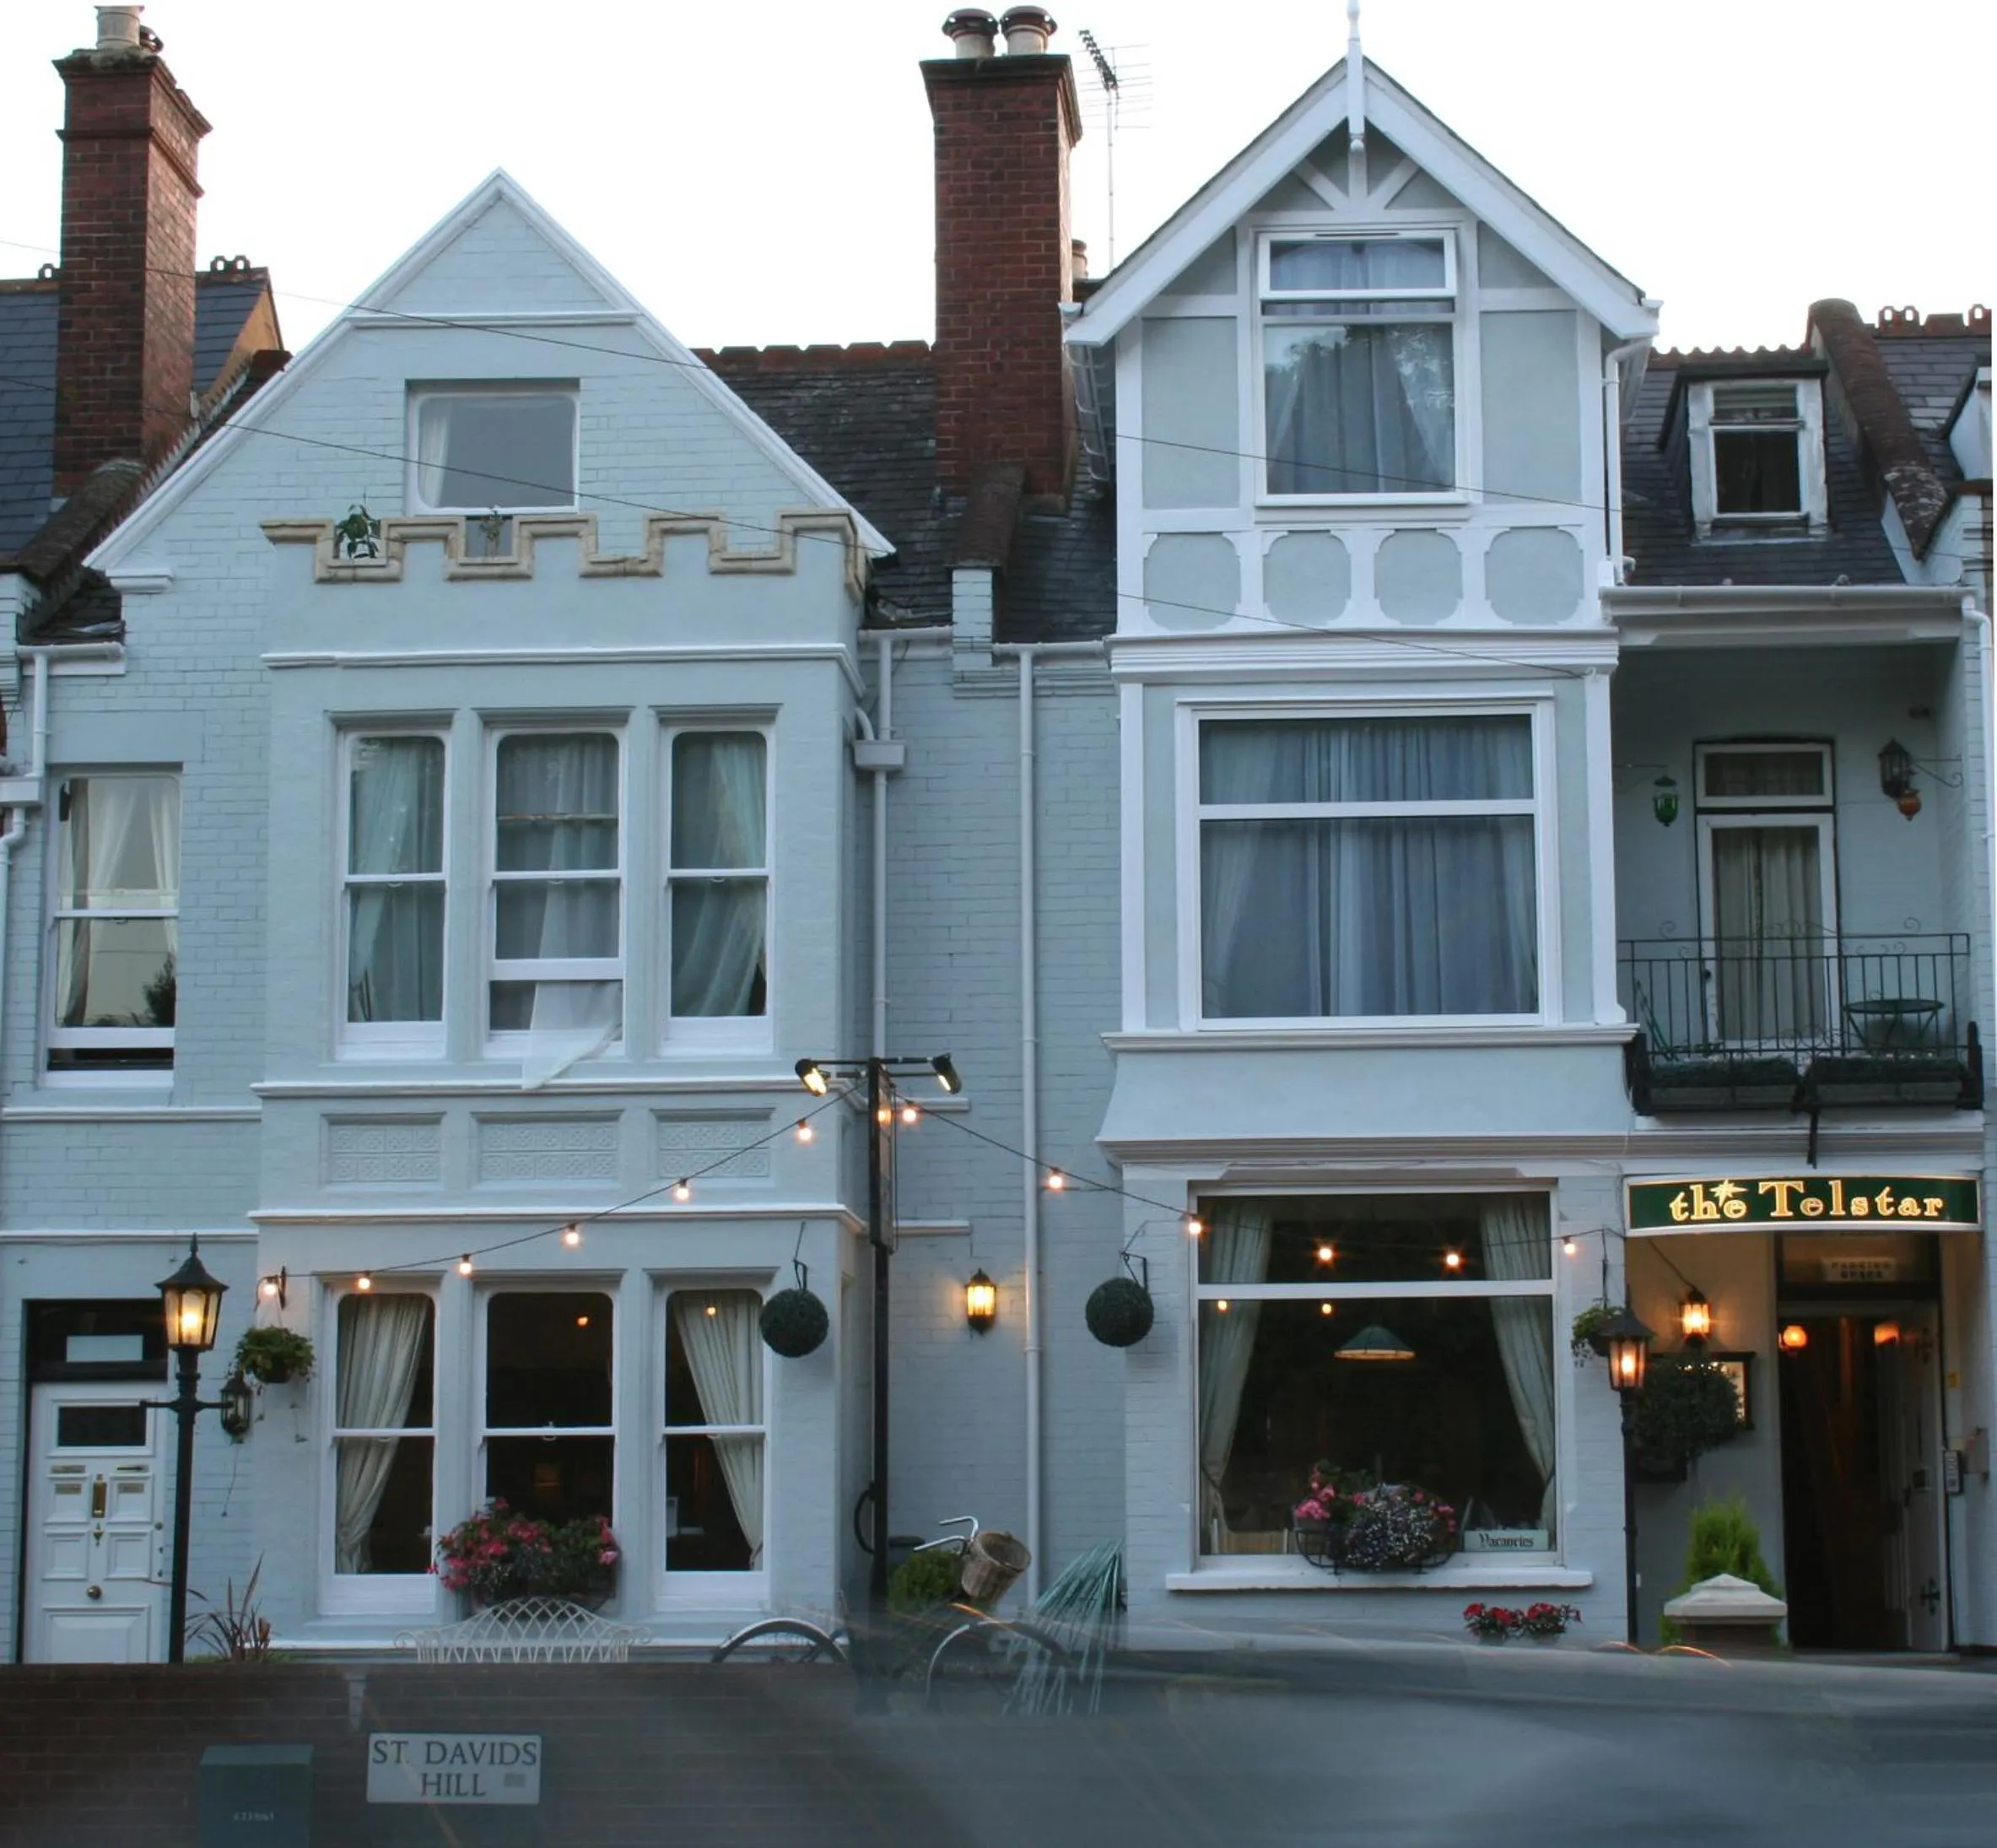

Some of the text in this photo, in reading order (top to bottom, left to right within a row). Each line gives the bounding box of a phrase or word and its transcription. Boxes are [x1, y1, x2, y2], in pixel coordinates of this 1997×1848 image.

[1669, 1180, 1944, 1221] the Telstar
[424, 1740, 537, 1766] DAVIDS
[420, 1772, 486, 1797] HILL
